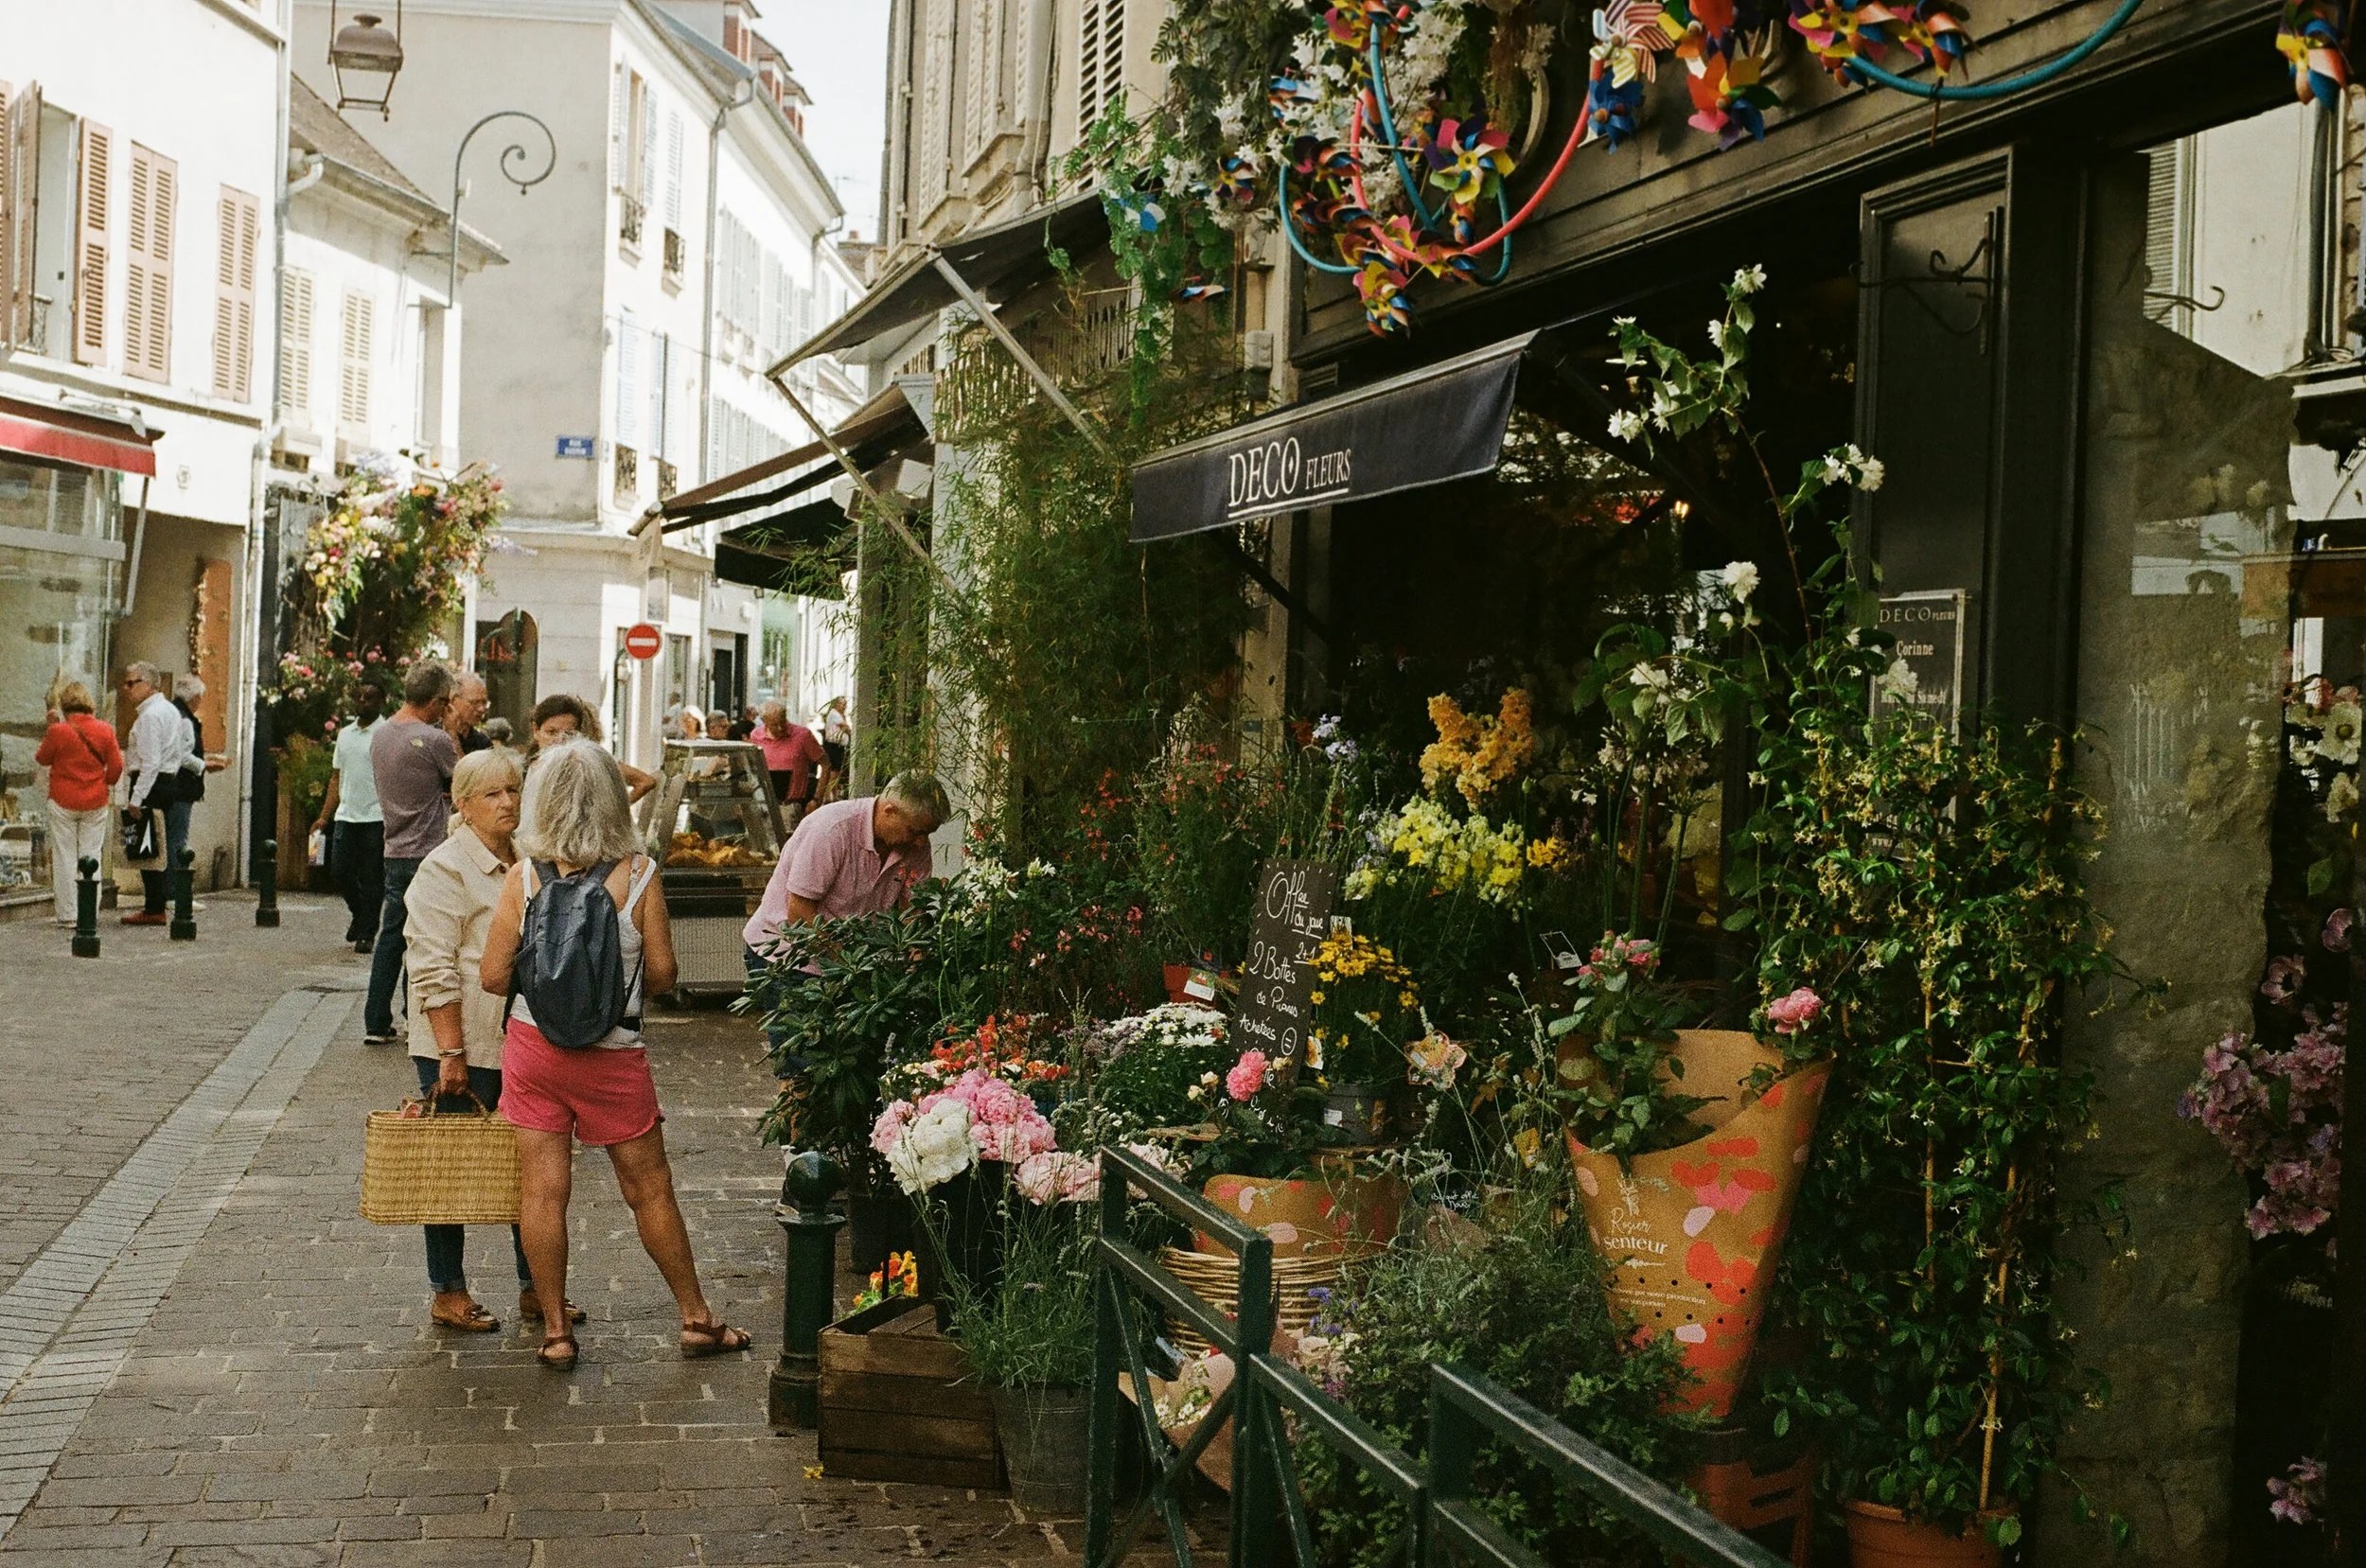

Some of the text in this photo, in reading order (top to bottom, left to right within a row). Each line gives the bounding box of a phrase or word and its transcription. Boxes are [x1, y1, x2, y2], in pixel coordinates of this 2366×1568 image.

[1228, 437, 1351, 507] DECO FLEURS
[1880, 607, 1931, 623] DECO
[1896, 640, 1933, 656] Corinne
[1266, 871, 1310, 925] Offre
[1294, 911, 1323, 935] du jour
[1249, 941, 1296, 984] 2 Bottes
[1257, 991, 1266, 1006] de
[1239, 1013, 1276, 1041] Achetées
[1604, 1236, 1668, 1255] senteur
